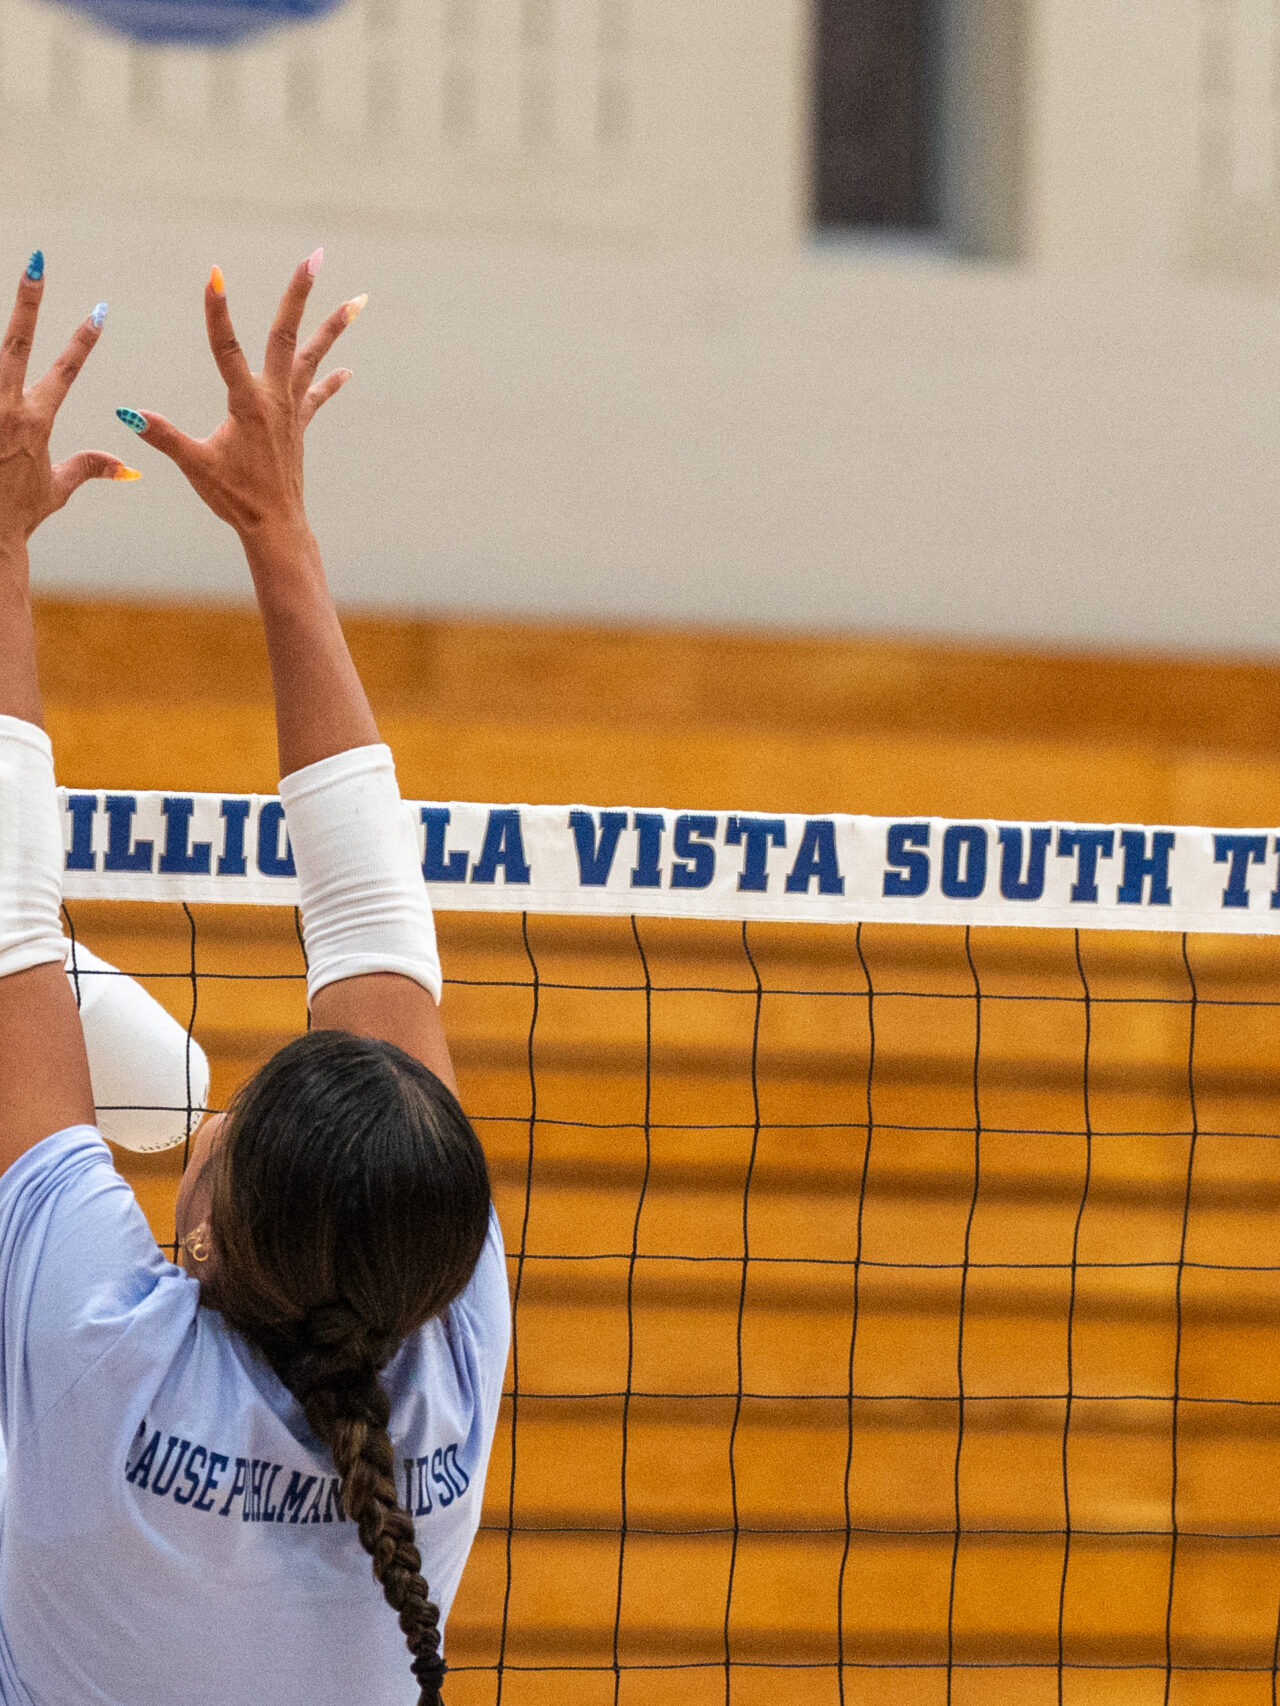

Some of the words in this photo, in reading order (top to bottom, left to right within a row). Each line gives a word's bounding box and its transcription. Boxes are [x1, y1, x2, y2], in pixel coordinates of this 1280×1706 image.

[420, 807, 531, 885] LA
[568, 811, 846, 896] VISTA
[881, 823, 1176, 906] SOUTH
[125, 1419, 230, 1513] AUSE
